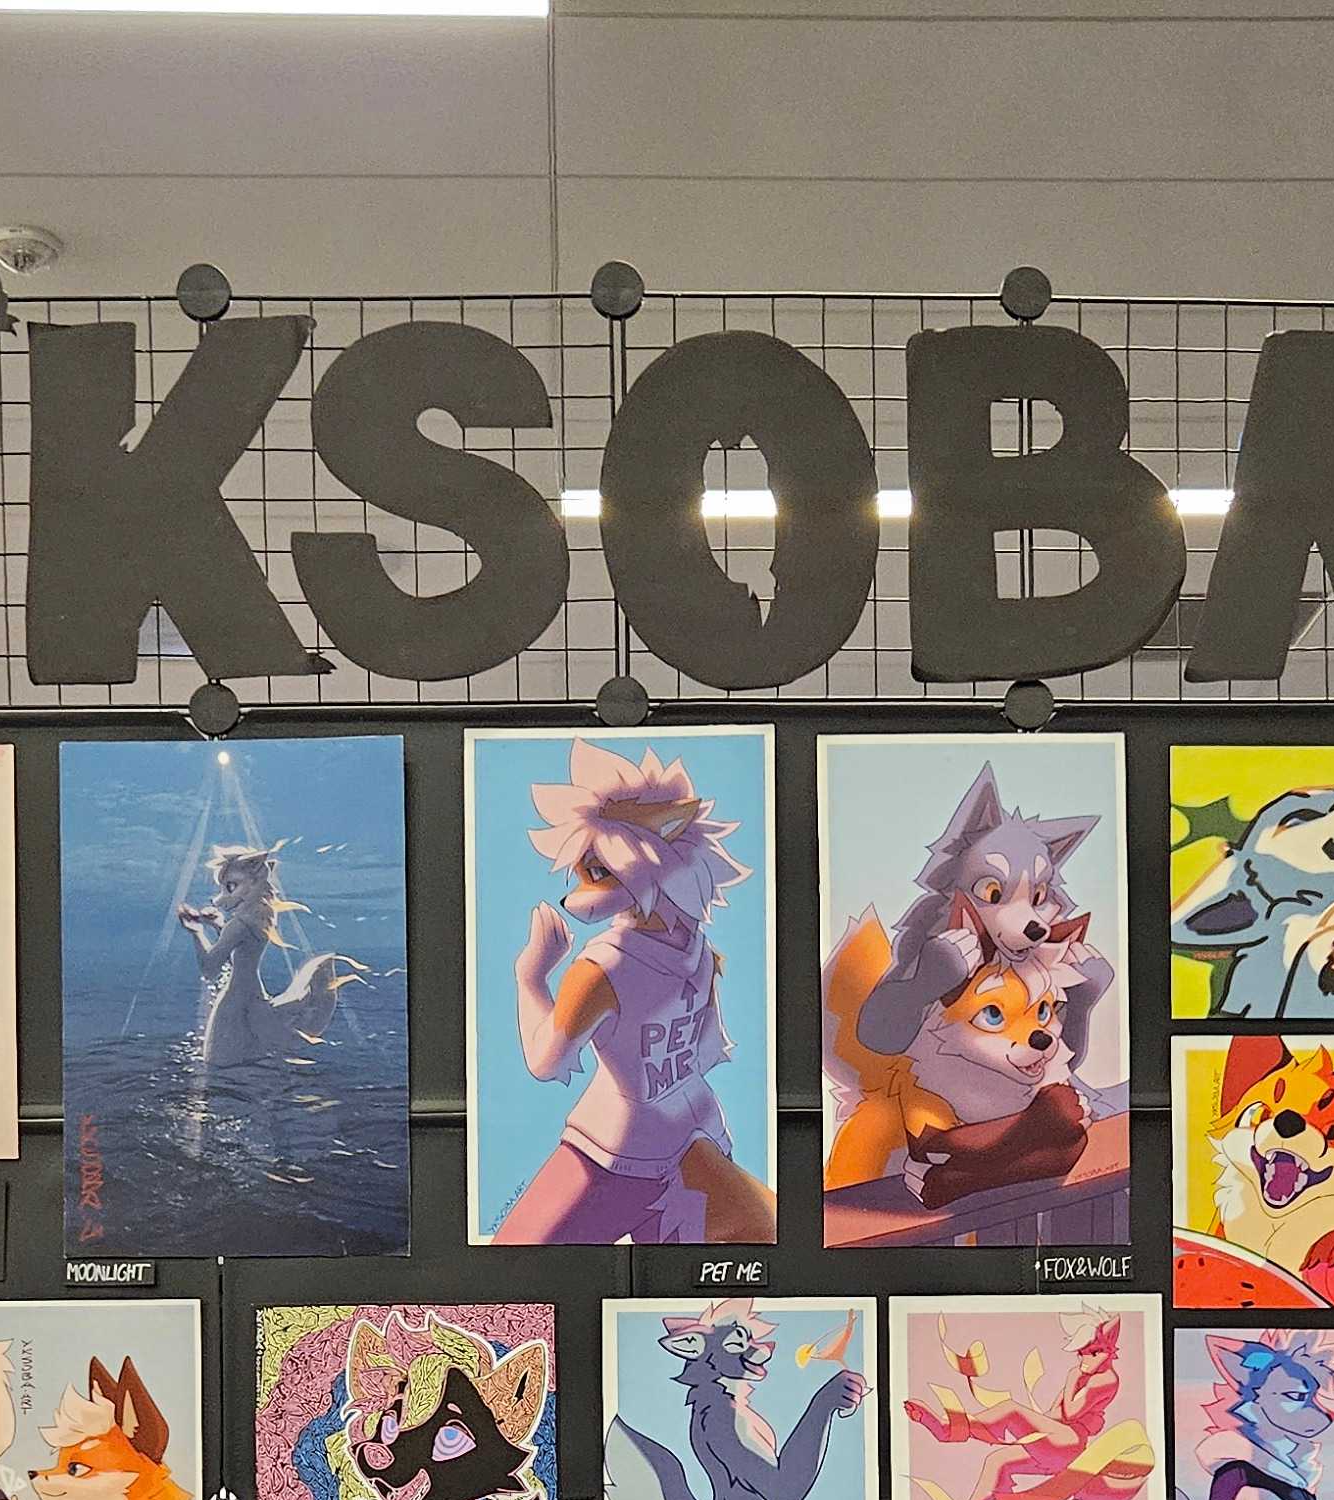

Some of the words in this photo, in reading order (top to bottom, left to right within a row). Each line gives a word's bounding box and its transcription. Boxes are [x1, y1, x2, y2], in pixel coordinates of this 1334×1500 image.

[640, 1006, 707, 1058] PET
[644, 1050, 694, 1101] ME
[67, 1262, 152, 1283] MOONLIGHT
[699, 1261, 733, 1283] PET
[736, 1261, 763, 1282] ME
